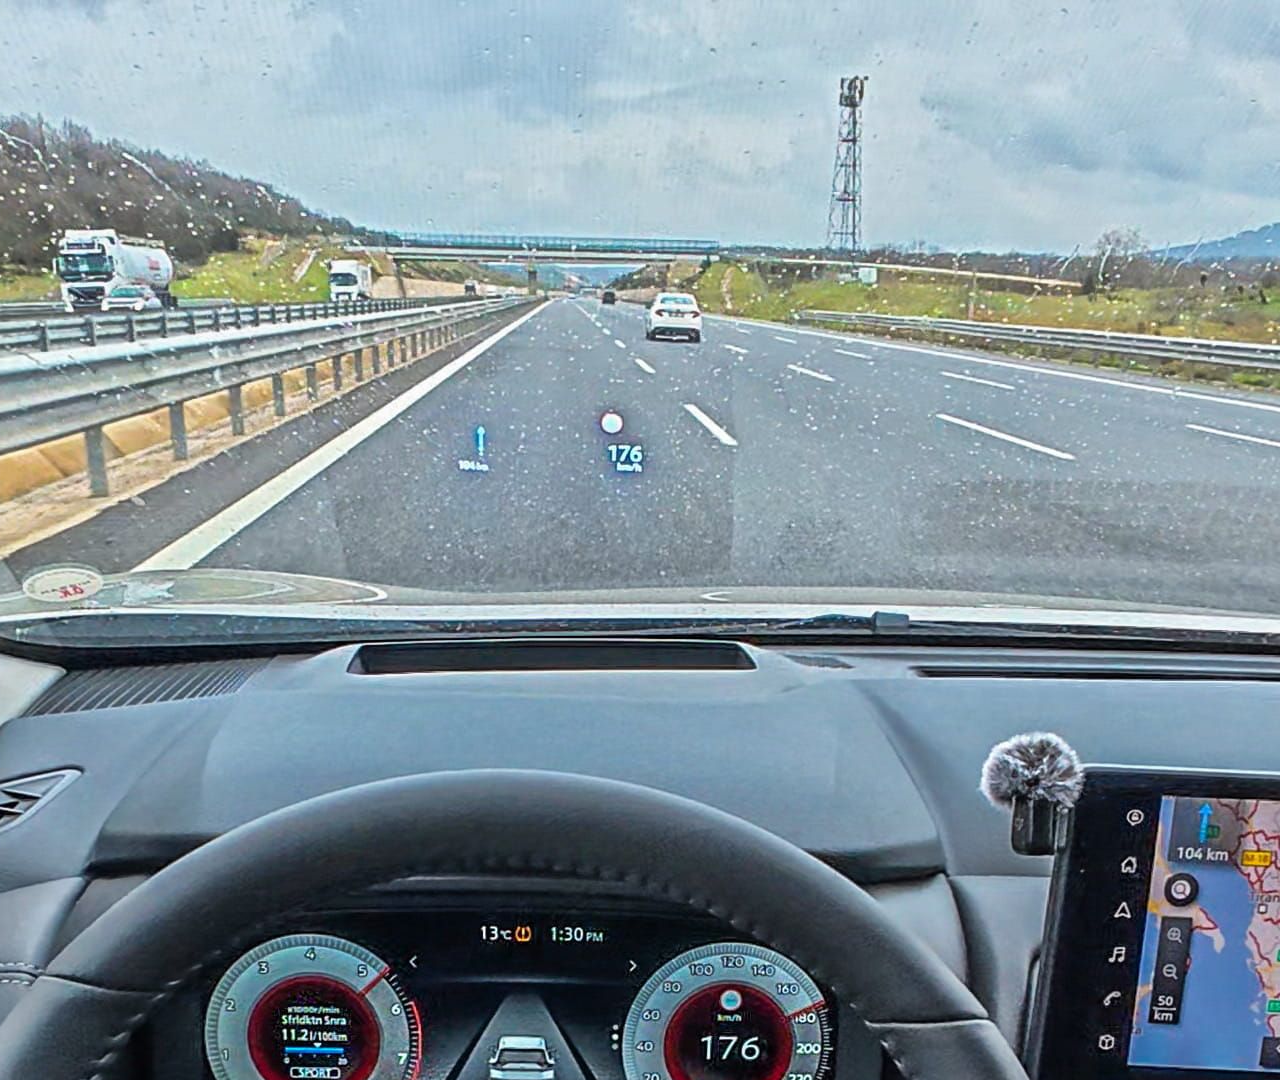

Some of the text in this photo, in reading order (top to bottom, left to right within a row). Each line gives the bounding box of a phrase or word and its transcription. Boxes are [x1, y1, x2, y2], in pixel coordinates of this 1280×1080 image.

[608, 444, 643, 463] 176
[1177, 847, 1229, 861] 104 km
[550, 927, 604, 942] 1:30 PM
[305, 949, 315, 960] 4
[259, 961, 269, 974] 3
[722, 956, 745, 968] 120
[358, 965, 368, 977] 5
[689, 964, 714, 976] 100
[752, 965, 775, 976] 140
[663, 983, 681, 993] 80
[776, 983, 799, 995] 160
[226, 1000, 235, 1011] 2
[1158, 995, 1174, 1006] 50
[391, 1004, 401, 1015] 6
[324, 1015, 347, 1025] Snra
[643, 1011, 660, 1020] 60
[793, 1013, 816, 1023] 180
[1154, 1010, 1174, 1021] km
[636, 1041, 654, 1051] 40
[700, 1035, 761, 1060] 176
[796, 1043, 821, 1054] 200
[223, 1049, 229, 1060] 1
[398, 1053, 407, 1065] 7
[298, 1067, 331, 1078] SPORT
